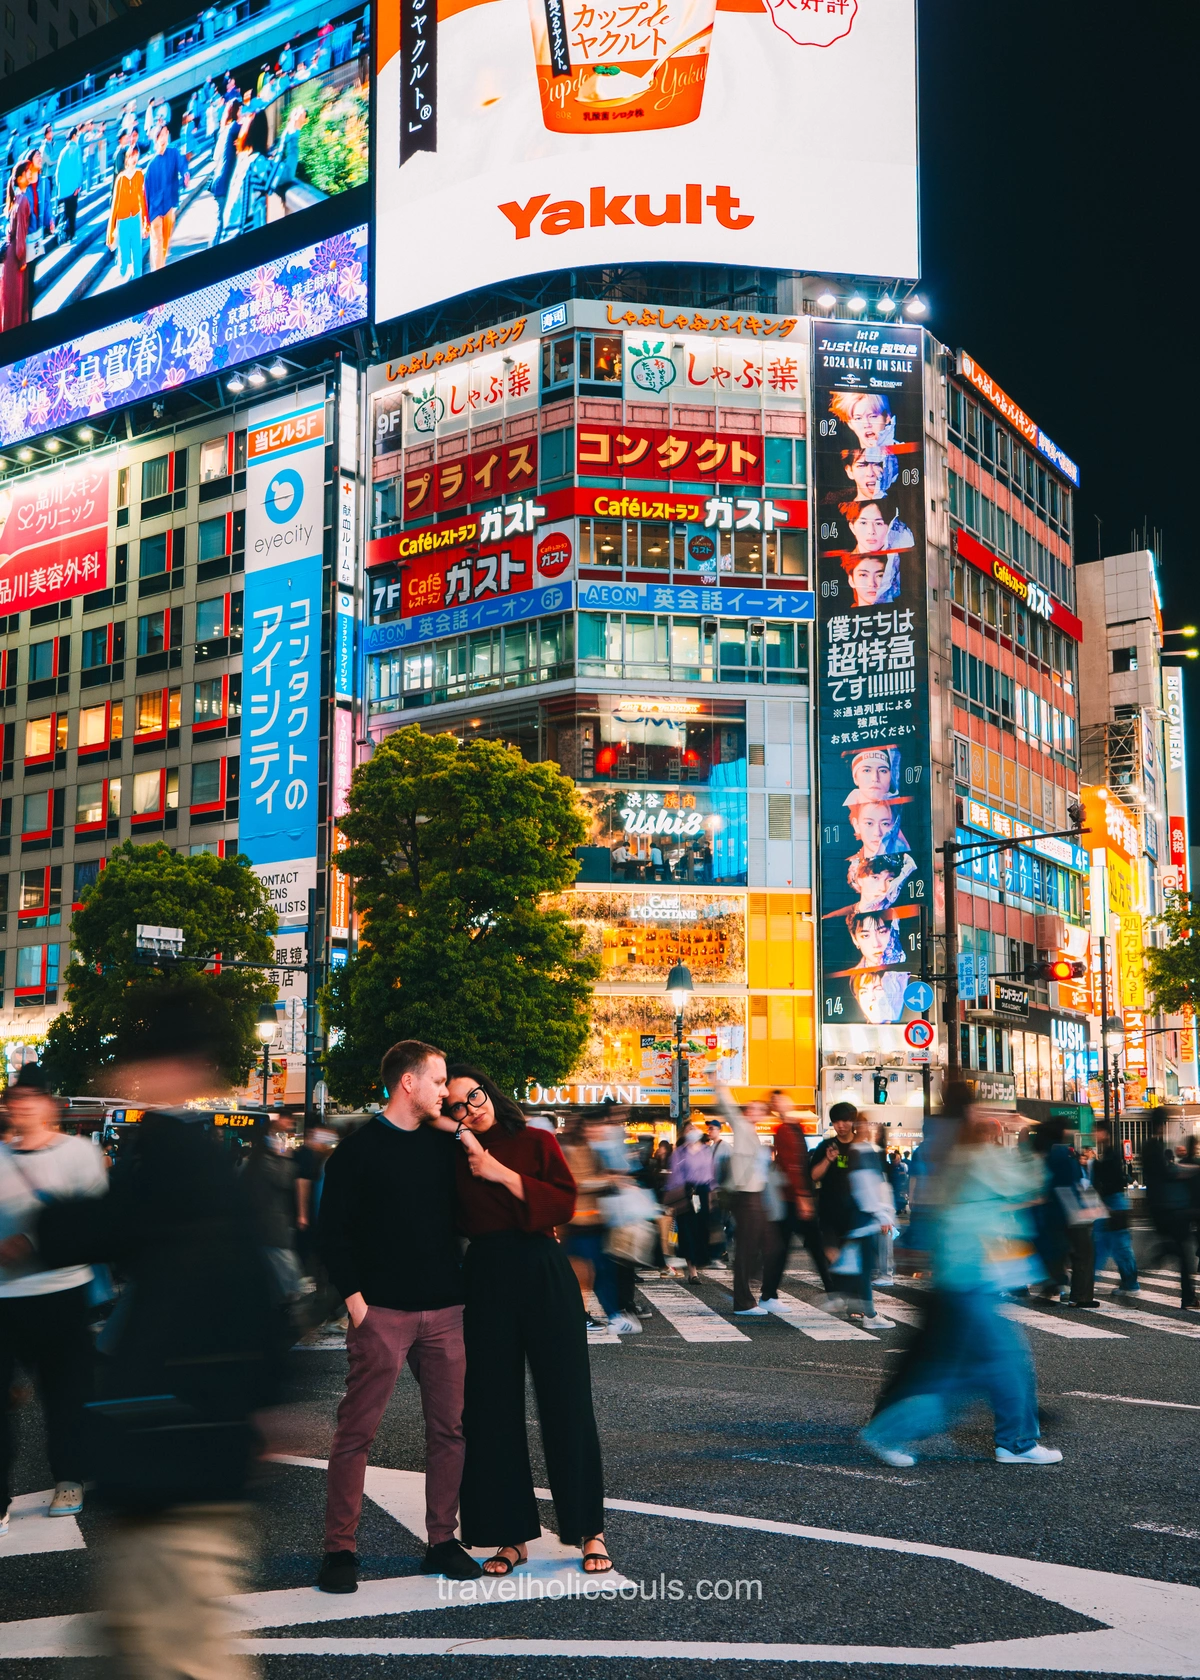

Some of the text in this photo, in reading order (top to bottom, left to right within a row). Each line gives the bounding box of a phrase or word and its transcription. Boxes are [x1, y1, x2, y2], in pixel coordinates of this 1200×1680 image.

[571, 28, 667, 59] ヤクルト
[497, 183, 755, 240] Yakult
[606, 304, 798, 338] しゃぶしゃぶバイキング
[818, 340, 853, 353] Just
[853, 341, 879, 354] like
[856, 330, 880, 341] 1st EP
[386, 318, 527, 382] しゃぶしゃぶバイキング
[688, 352, 799, 392] しゃぶ葉
[823, 356, 913, 373] 2024.04.17 ON SALE
[450, 362, 531, 414] しゃぶ葉
[255, 417, 318, 453] 当ビル5F
[377, 410, 400, 434] 9F
[820, 419, 837, 436] 02
[579, 433, 758, 475] コンタクト
[406, 444, 534, 509] プライス
[902, 468, 919, 486] 03
[35, 474, 104, 511] 品川スキン
[35, 499, 95, 534] クリニック
[480, 499, 546, 543] ガスト
[703, 496, 790, 531] ガスト
[254, 524, 314, 557] eyecity
[820, 522, 838, 540] 04
[541, 551, 569, 567] ガスト
[408, 572, 441, 596] Café
[445, 551, 525, 606] ガスト
[821, 580, 838, 598] 05
[373, 582, 400, 612] 7F
[408, 592, 441, 609] レストラン
[586, 586, 639, 606] AEON
[1027, 582, 1053, 620] ガスト
[369, 624, 406, 647] AEON
[827, 608, 916, 643] 僕たちは
[827, 635, 916, 678] 超特急
[250, 605, 284, 815] アイシティ
[285, 598, 310, 811] コンタクトの
[830, 725, 916, 744] お気をつけください
[857, 714, 889, 729] 強風に
[1167, 676, 1182, 770] BIC CAMERA
[905, 766, 922, 784] 07
[627, 791, 697, 810] 渋谷 焼肉
[620, 808, 704, 835] Ushi8
[824, 825, 839, 843] 11
[1172, 829, 1185, 853] 免税
[1075, 848, 1088, 871] 4F
[257, 872, 299, 887] ONTACT
[908, 881, 924, 898] 12
[268, 887, 288, 900] ENS
[1123, 917, 1139, 1002] 処方せん 3F
[965, 956, 974, 996] 渋谷駅前
[825, 997, 843, 1016] 14
[1050, 1018, 1084, 1052] LUSH
[1126, 1013, 1145, 1068] スギ薬
[514, 1082, 650, 1105] OCCITANE
[981, 1082, 1014, 1100] サンドラッグ
